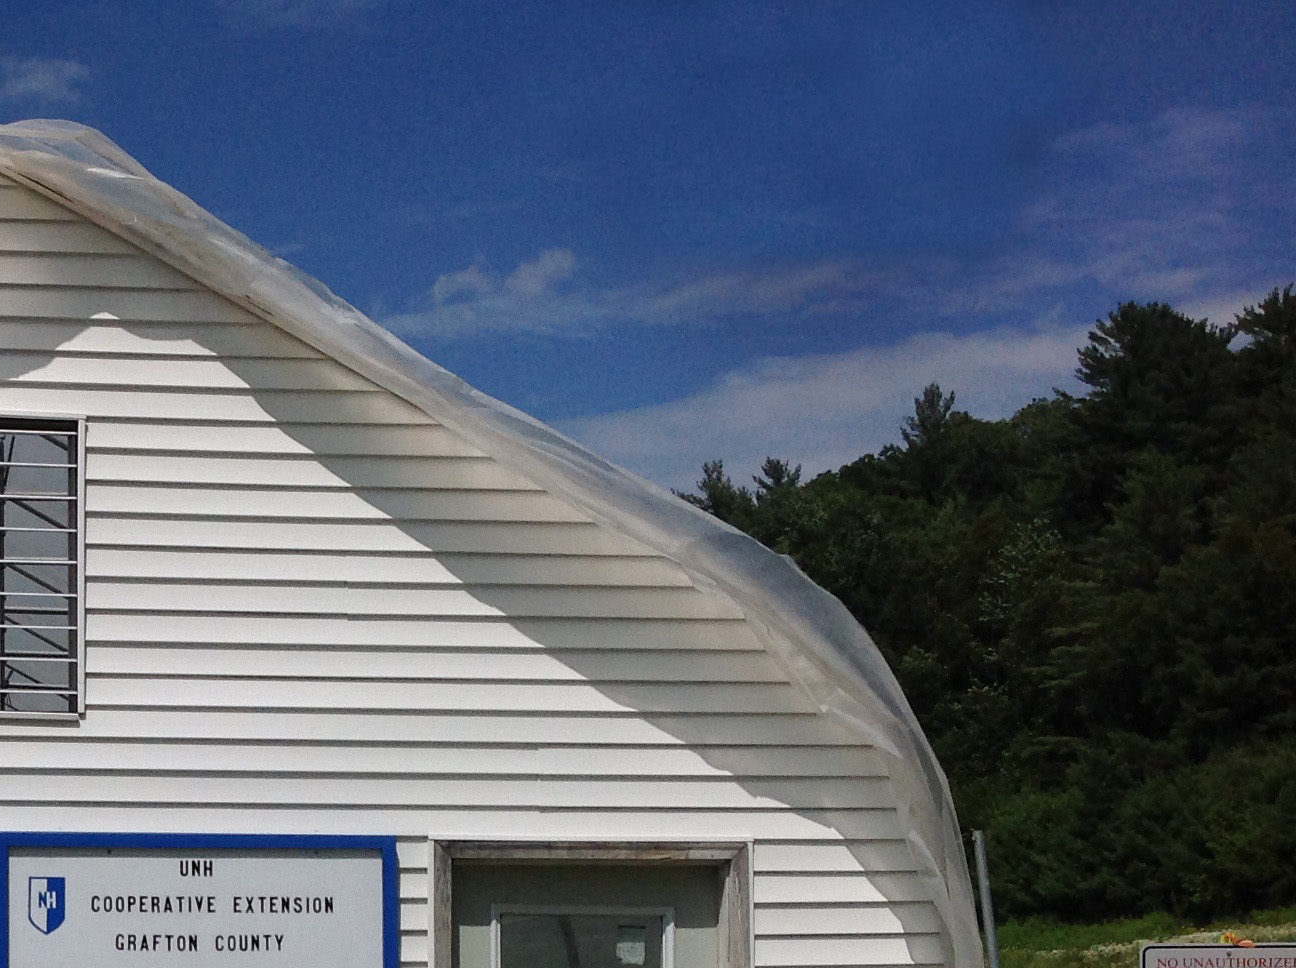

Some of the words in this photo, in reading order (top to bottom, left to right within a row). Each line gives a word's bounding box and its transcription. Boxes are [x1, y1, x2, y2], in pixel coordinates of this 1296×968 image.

[179, 860, 214, 877] UNH
[39, 891, 57, 909] NH
[91, 896, 217, 913] COOPERATIVE
[233, 896, 335, 914] EXTENSION
[115, 935, 198, 952] GRAFTON
[215, 935, 285, 952] COUNTY
[1183, 958, 1296, 968] UNAUTHORIZE
